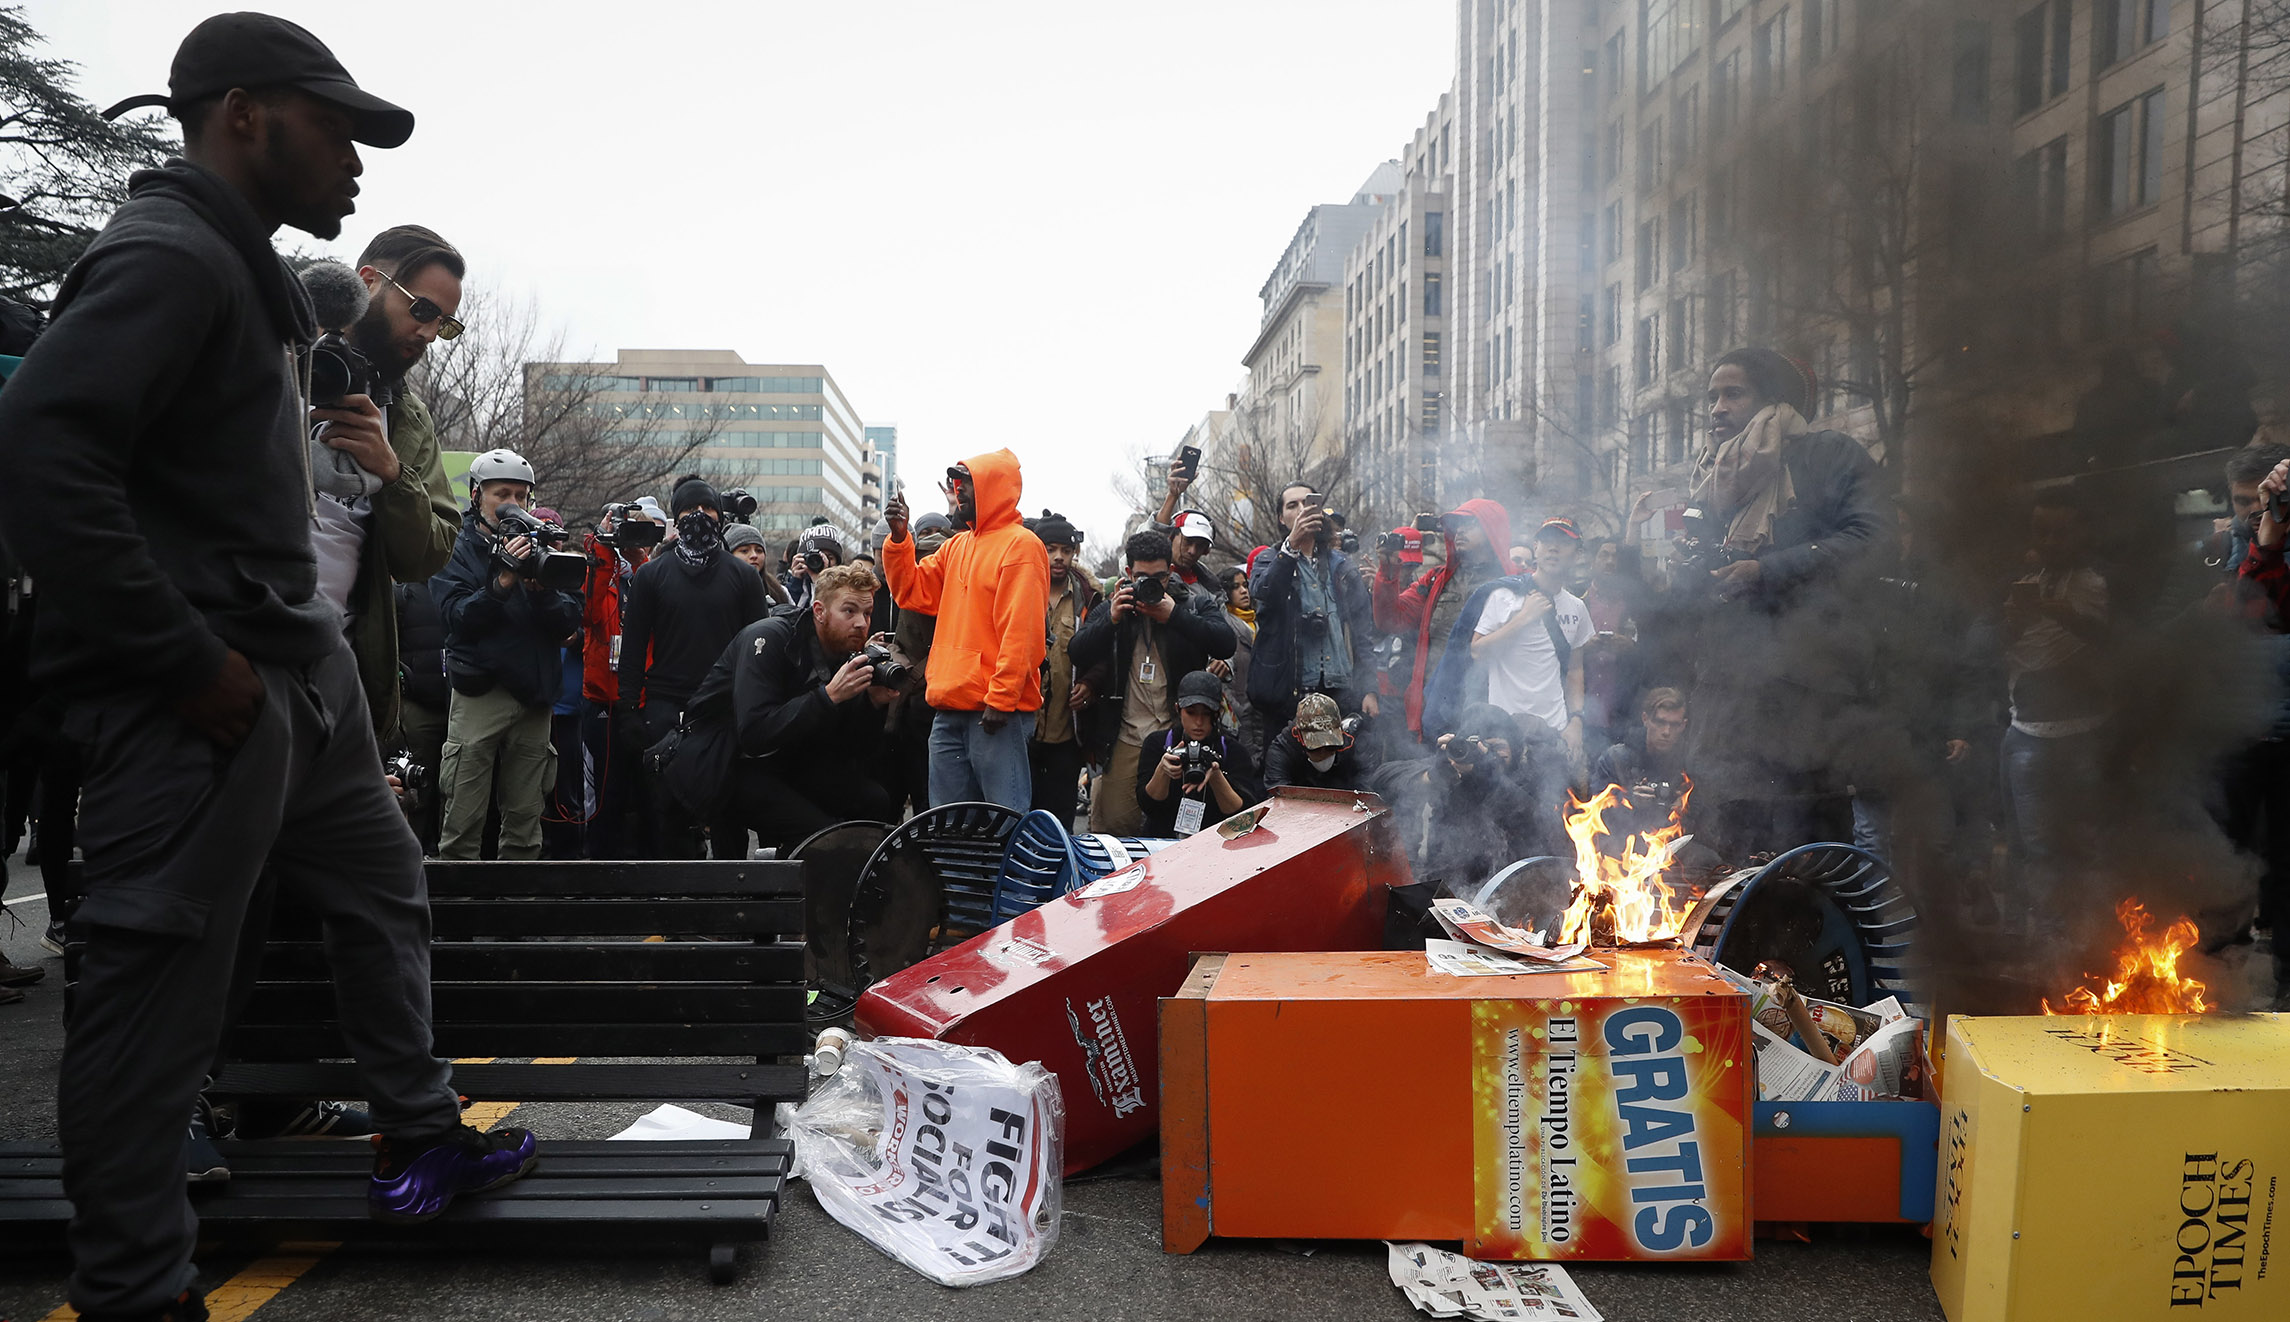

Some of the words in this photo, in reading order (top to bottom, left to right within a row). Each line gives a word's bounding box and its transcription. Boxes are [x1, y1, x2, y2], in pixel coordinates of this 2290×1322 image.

[1087, 999, 1147, 1119] Examiner
[1099, 1061, 1115, 1094] WASHINGTON
[1549, 1017, 1577, 1043] El
[1504, 1028, 1525, 1230] www.eltiempolatino.com
[1541, 1049, 1577, 1150] Tiempo
[1604, 1006, 1714, 1251] GRATIS
[945, 1141, 980, 1231] FOR
[1549, 1156, 1577, 1242] Latino
[2169, 1151, 2218, 1309] EPOCH
[2208, 1158, 2255, 1300] TIMES
[2257, 1176, 2277, 1280] TheEpochTimes.com
